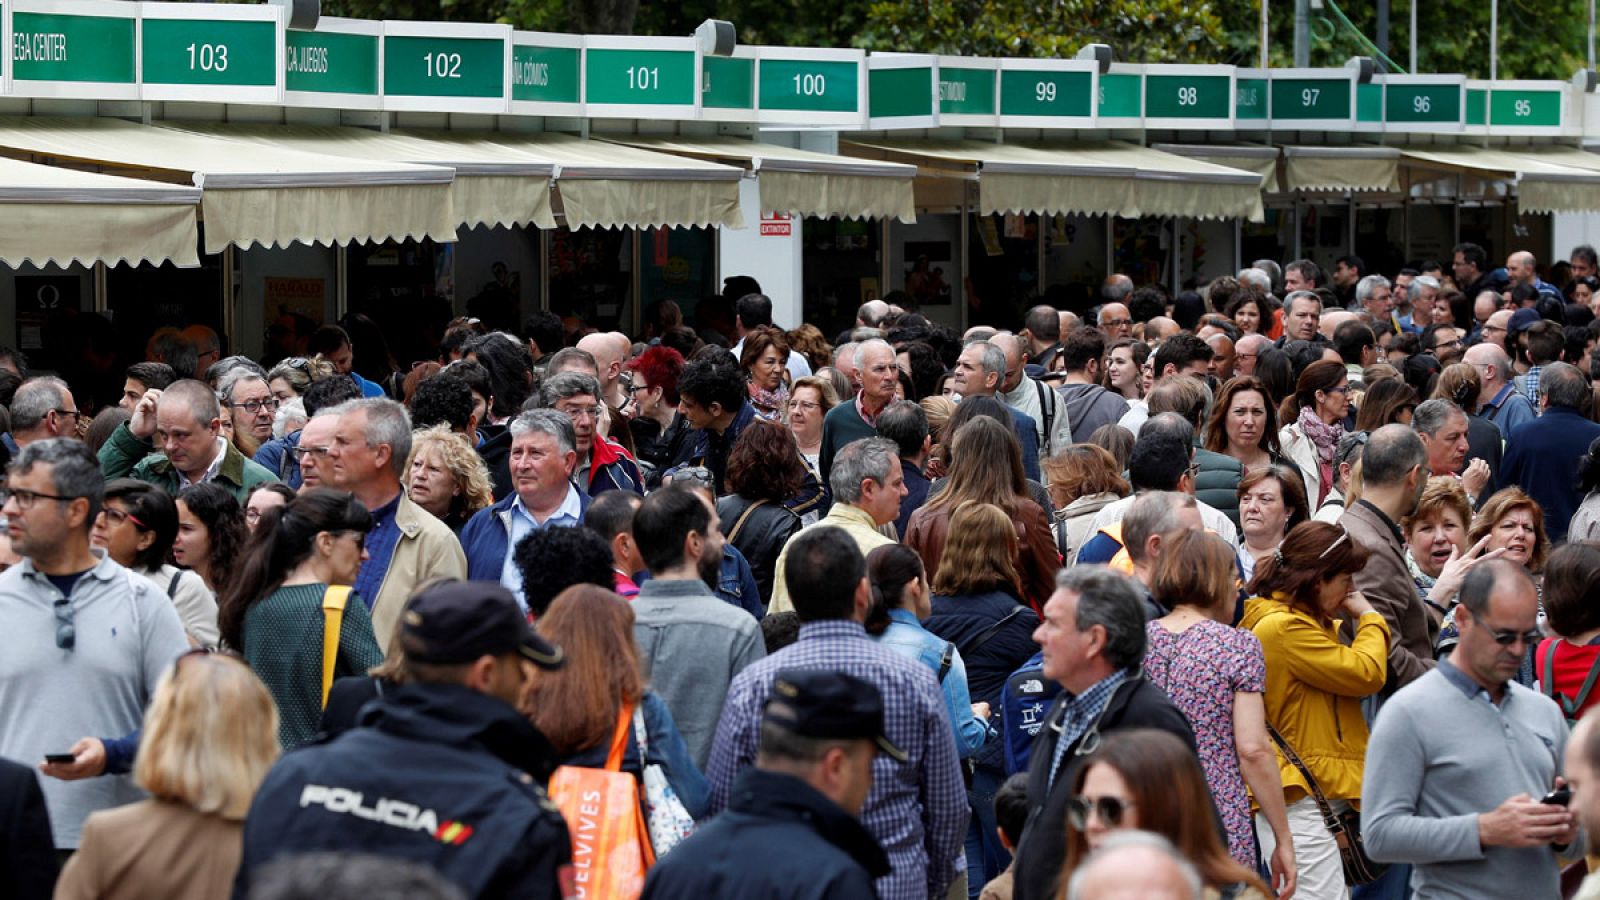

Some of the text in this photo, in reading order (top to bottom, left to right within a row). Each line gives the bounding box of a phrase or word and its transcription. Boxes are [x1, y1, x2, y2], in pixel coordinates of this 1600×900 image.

[33, 33, 67, 61] CENTER
[187, 44, 228, 71] 103
[299, 47, 328, 73] JUEGOS
[424, 53, 462, 78] 102
[524, 56, 549, 86] CÓMICS
[627, 67, 659, 89] 101
[793, 73, 825, 96] 100
[1036, 82, 1057, 101] 99
[1178, 87, 1198, 105] 98
[1302, 89, 1320, 106] 97
[1414, 96, 1431, 113] 96
[1515, 100, 1532, 116] 95
[761, 224, 789, 233] EXTINTOR
[300, 784, 438, 835] POLICIA
